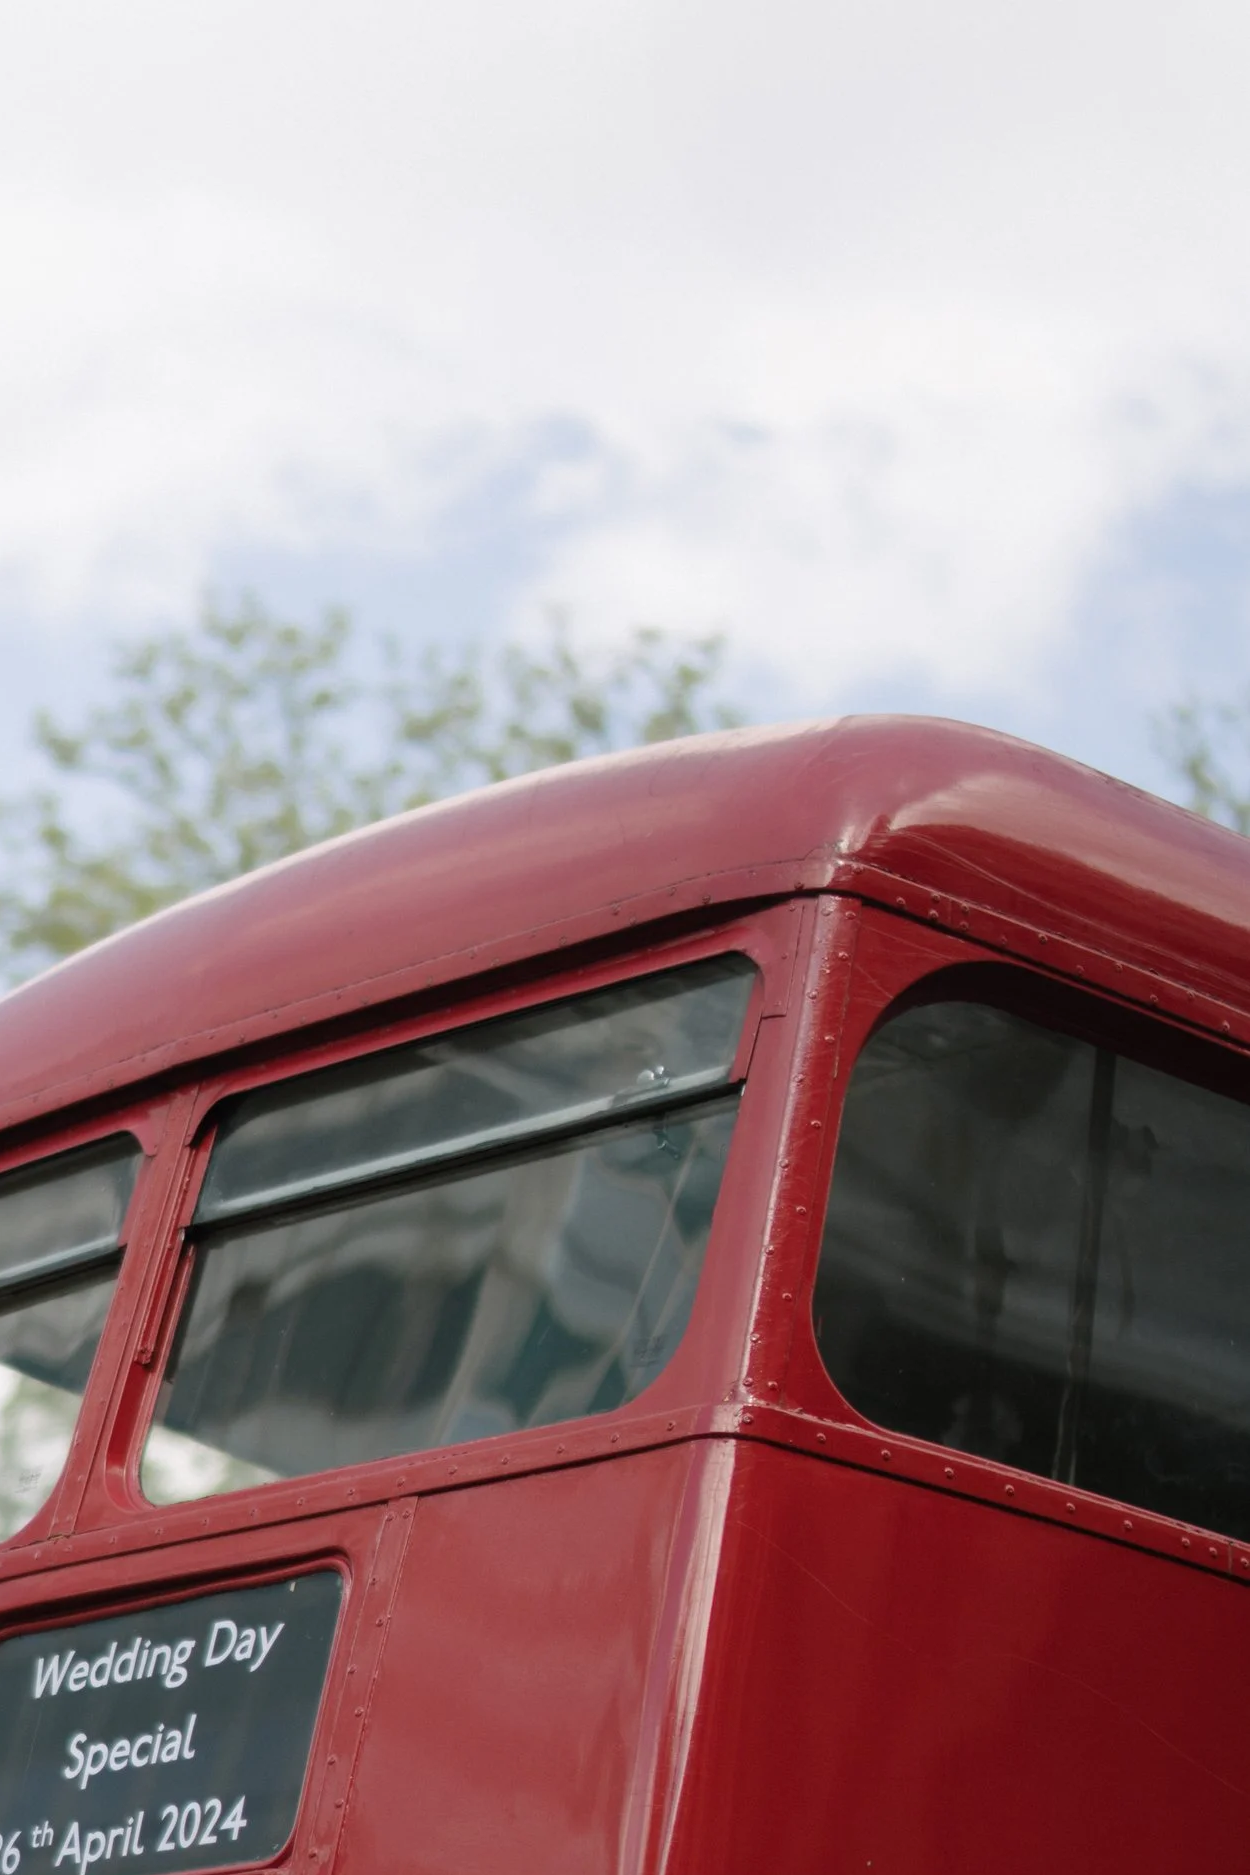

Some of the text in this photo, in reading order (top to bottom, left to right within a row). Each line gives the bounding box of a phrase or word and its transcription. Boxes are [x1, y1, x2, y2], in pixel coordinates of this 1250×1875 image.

[33, 1619, 286, 1699] Wedding Day
[63, 1713, 198, 1790] Special
[156, 1795, 248, 1852] 2024
